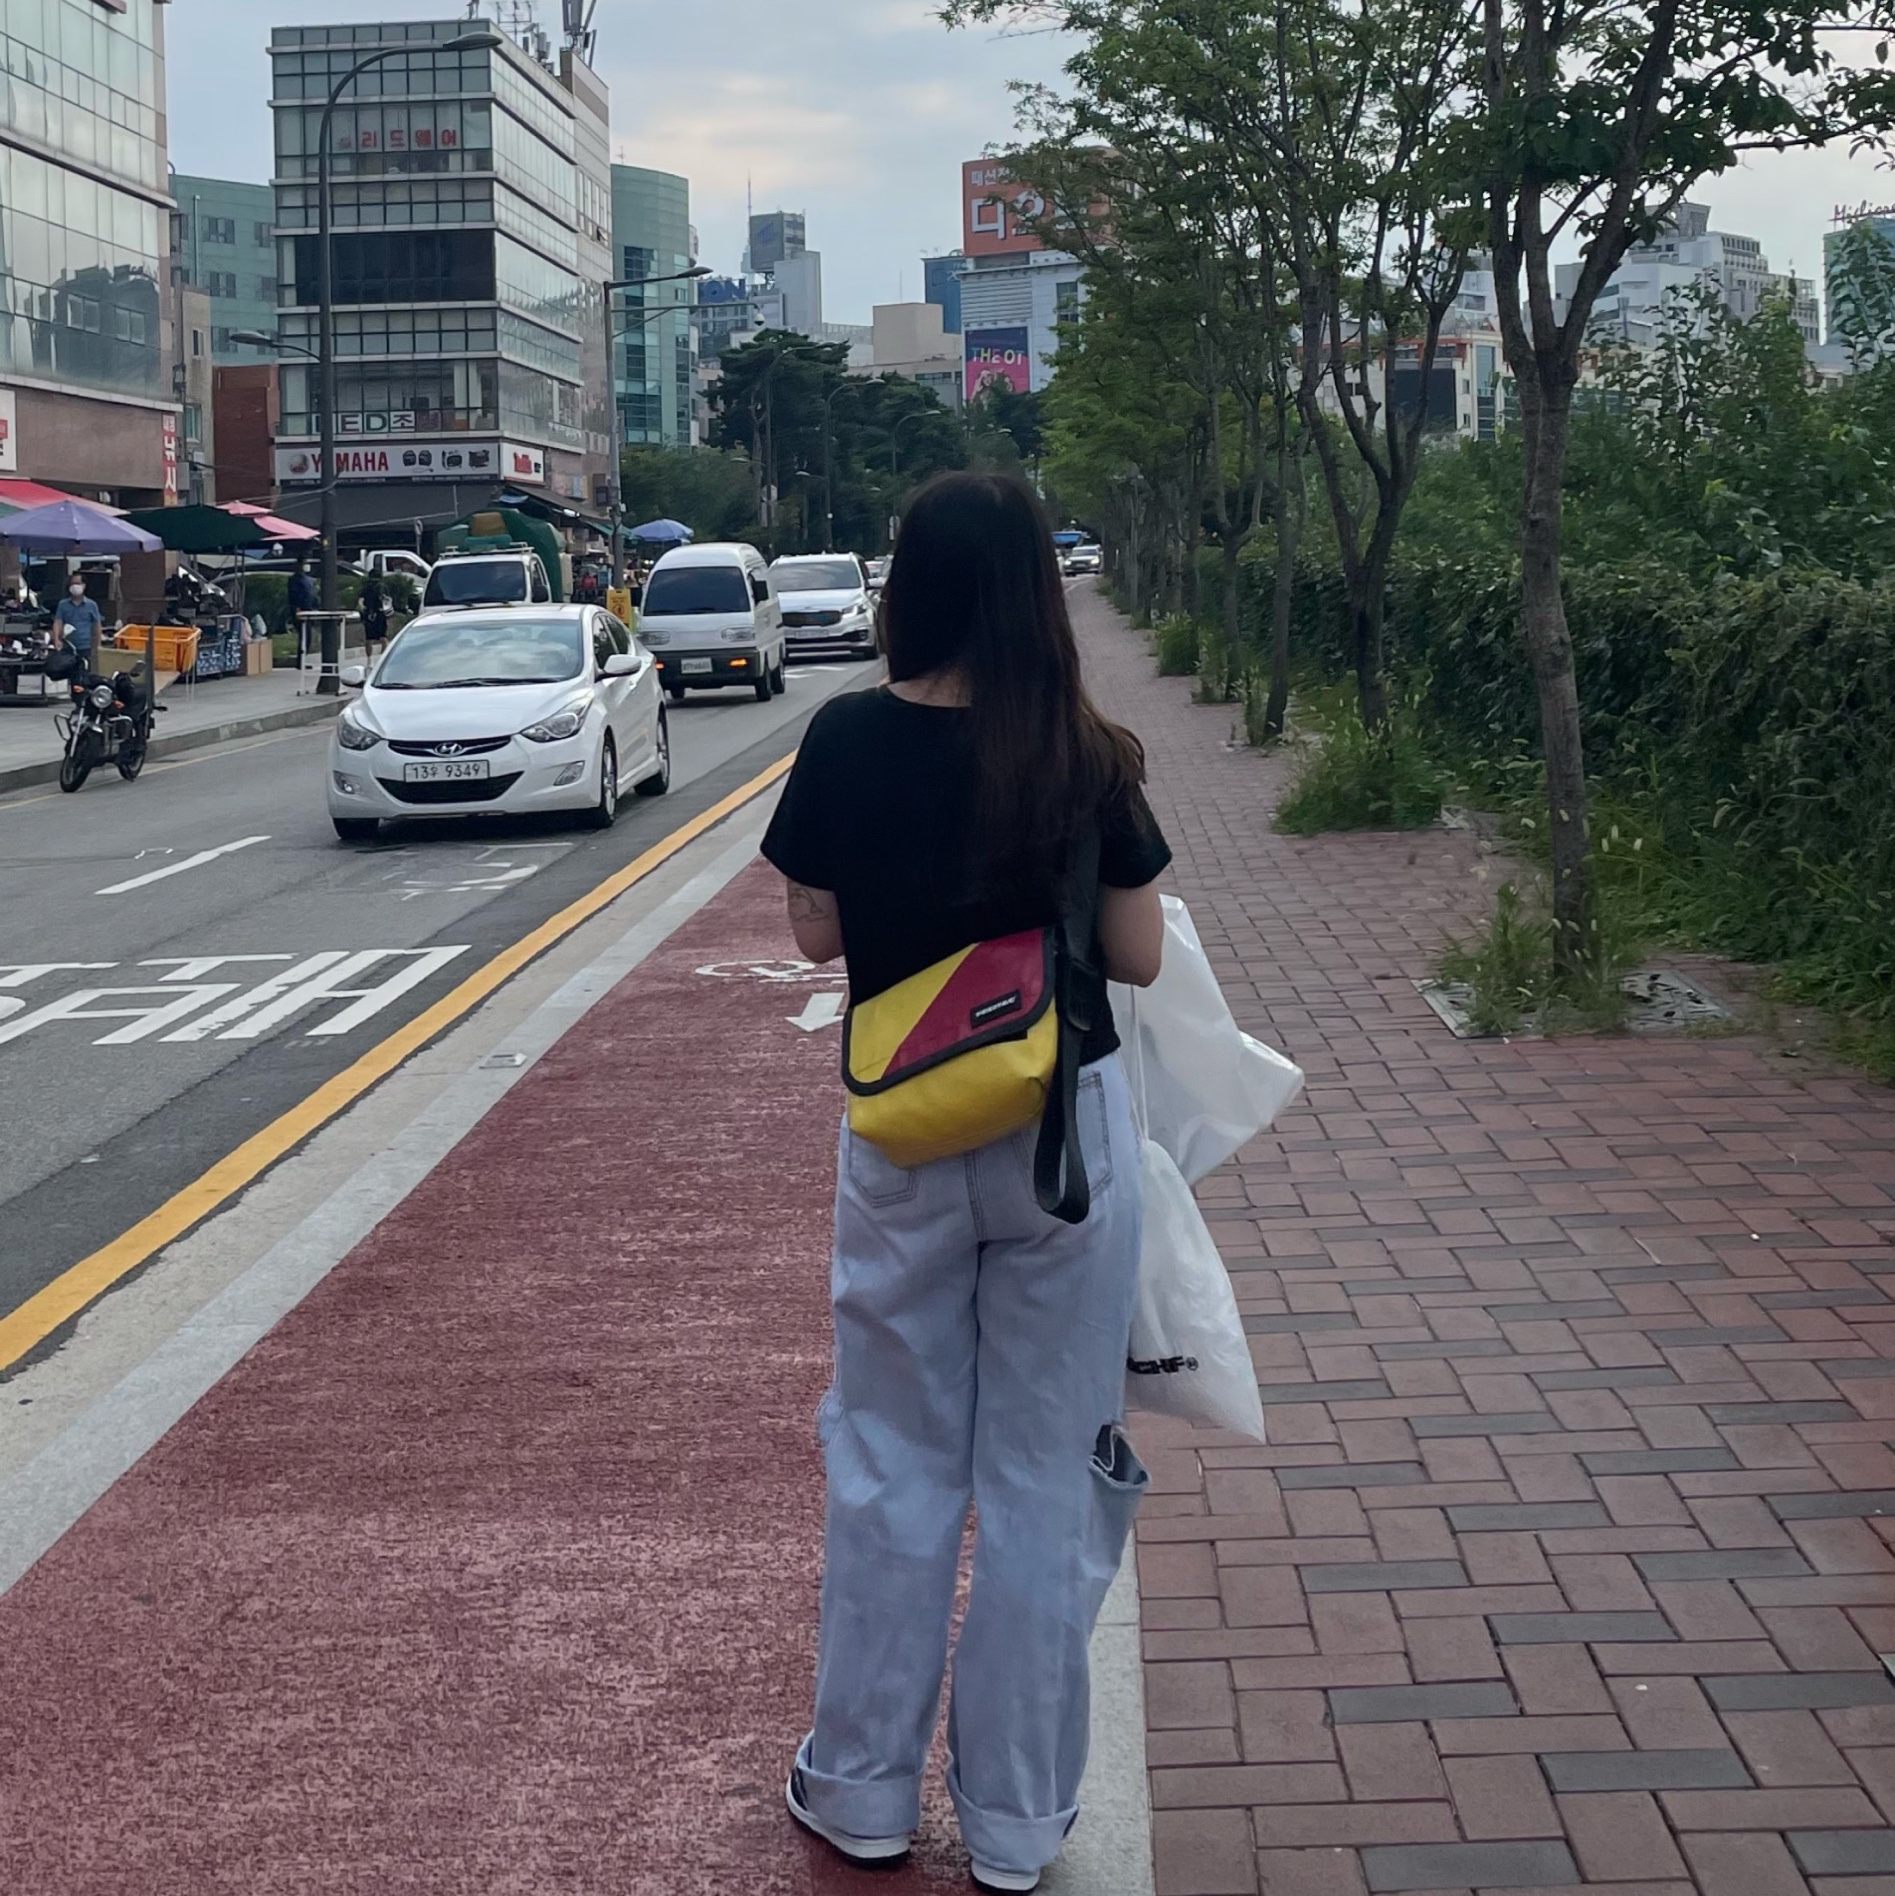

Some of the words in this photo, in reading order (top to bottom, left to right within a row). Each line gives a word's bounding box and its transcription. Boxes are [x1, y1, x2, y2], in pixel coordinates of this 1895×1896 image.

[971, 347, 1001, 364] THE
[311, 451, 389, 474] YMAHA
[445, 763, 481, 778] 9349
